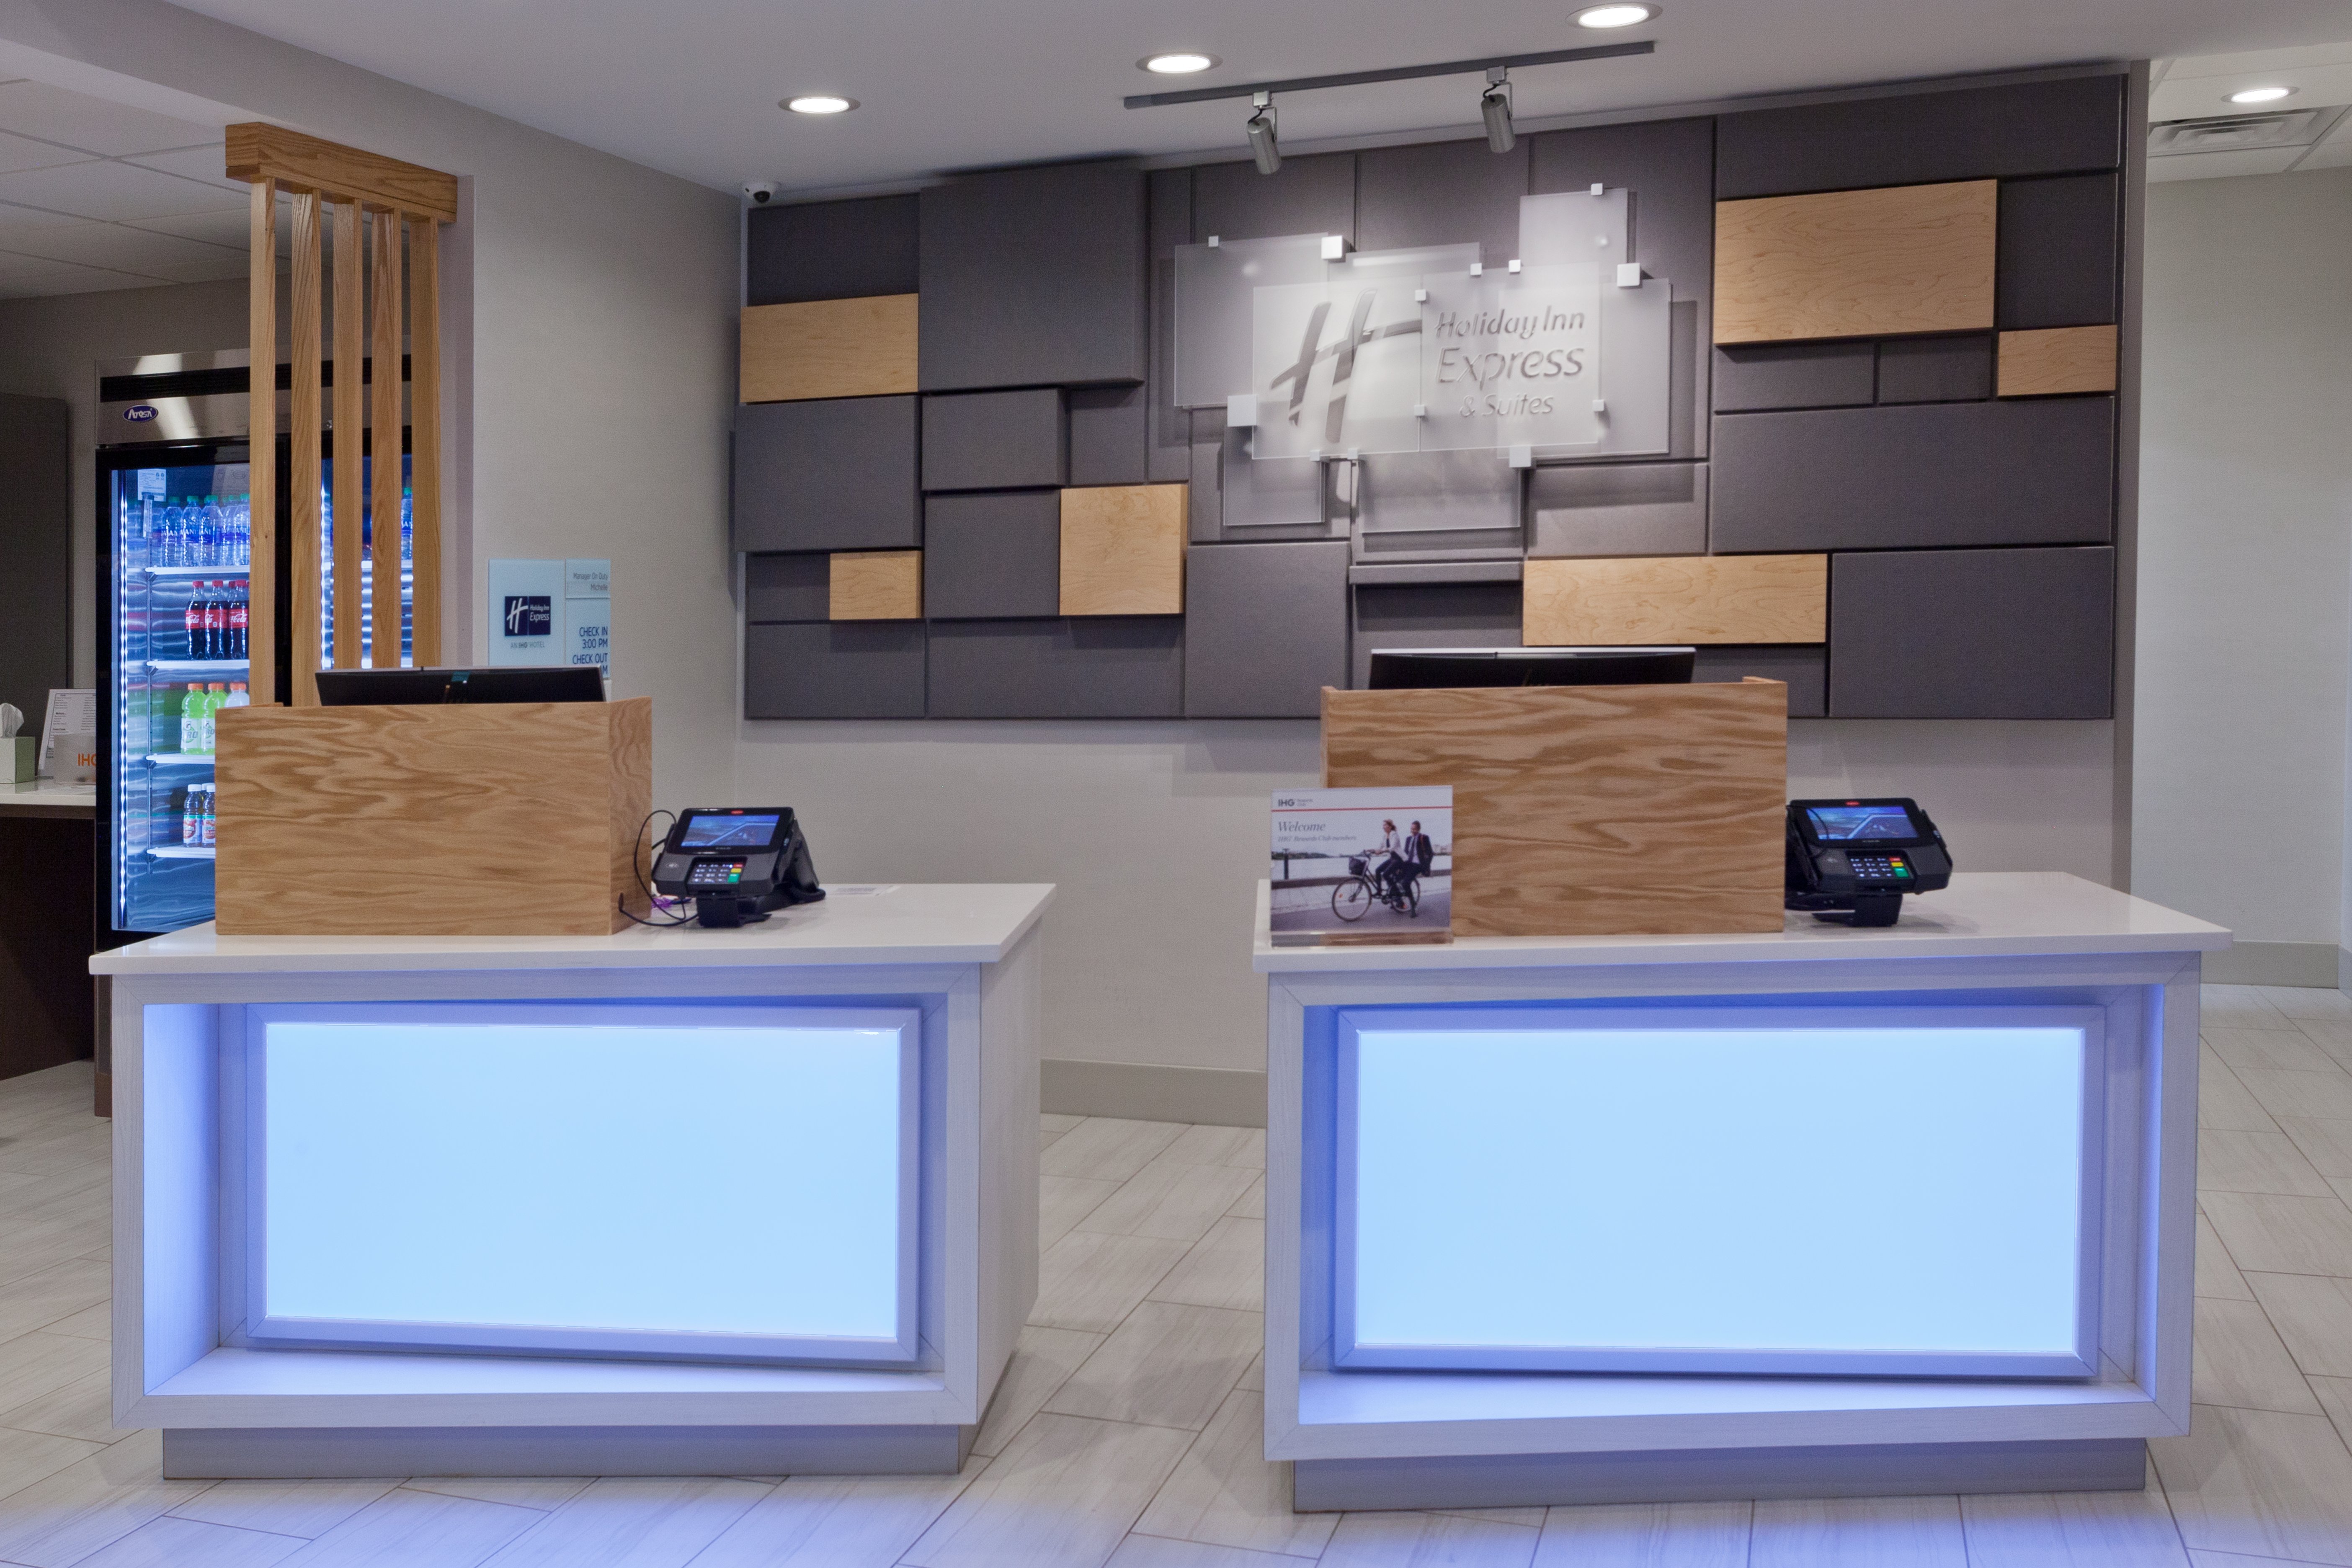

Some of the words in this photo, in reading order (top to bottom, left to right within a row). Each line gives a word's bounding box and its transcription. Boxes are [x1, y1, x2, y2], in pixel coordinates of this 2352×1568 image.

[1435, 308, 1538, 339] Holiday
[1543, 305, 1585, 331] Inn
[1436, 347, 1585, 390] Express
[1459, 395, 1475, 418] &
[1481, 394, 1554, 416] Suites
[530, 612, 549, 623] Express
[579, 627, 600, 637] CHECK
[601, 626, 608, 636] IN
[583, 639, 596, 649] 3:00
[598, 638, 608, 648] PM
[573, 654, 593, 665] CHECK
[595, 653, 608, 663] OUT
[1278, 821, 1326, 832] Welcome
